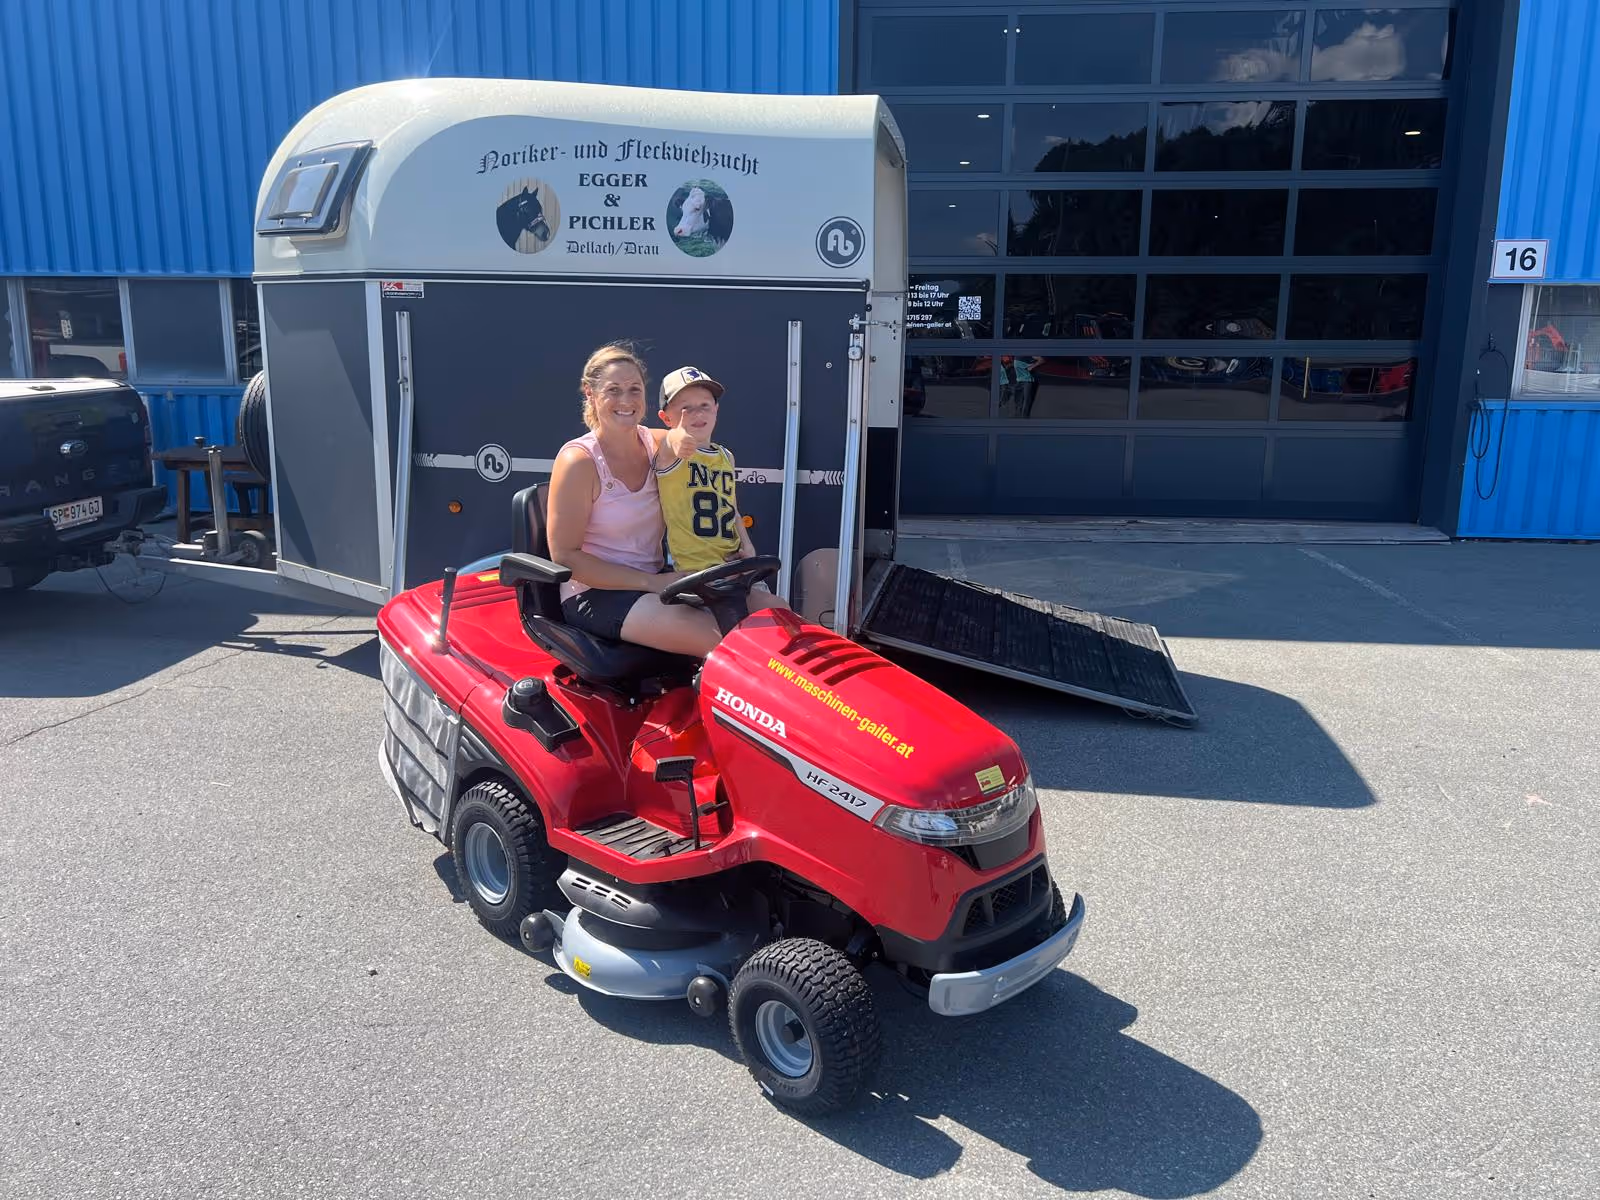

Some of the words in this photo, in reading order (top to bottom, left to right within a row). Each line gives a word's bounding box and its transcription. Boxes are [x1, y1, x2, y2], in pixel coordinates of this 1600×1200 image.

[476, 144, 566, 174] Noriker-
[574, 140, 608, 159] und
[614, 138, 759, 176] Fleckviehzucht
[578, 172, 648, 187] EGGER
[603, 193, 621, 207] &
[568, 215, 656, 231] PICHLER
[566, 240, 660, 256] Dellach/Drau
[1505, 247, 1537, 271] 16
[687, 462, 733, 495] NYC
[52, 509, 63, 524] SP
[70, 503, 87, 519] 974
[88, 500, 100, 515] GJ
[693, 491, 735, 538] 82
[714, 686, 788, 738] HONDA
[767, 657, 915, 759] www.maschinen-gailer.at
[806, 771, 829, 786] HF
[828, 784, 867, 808] 2417
